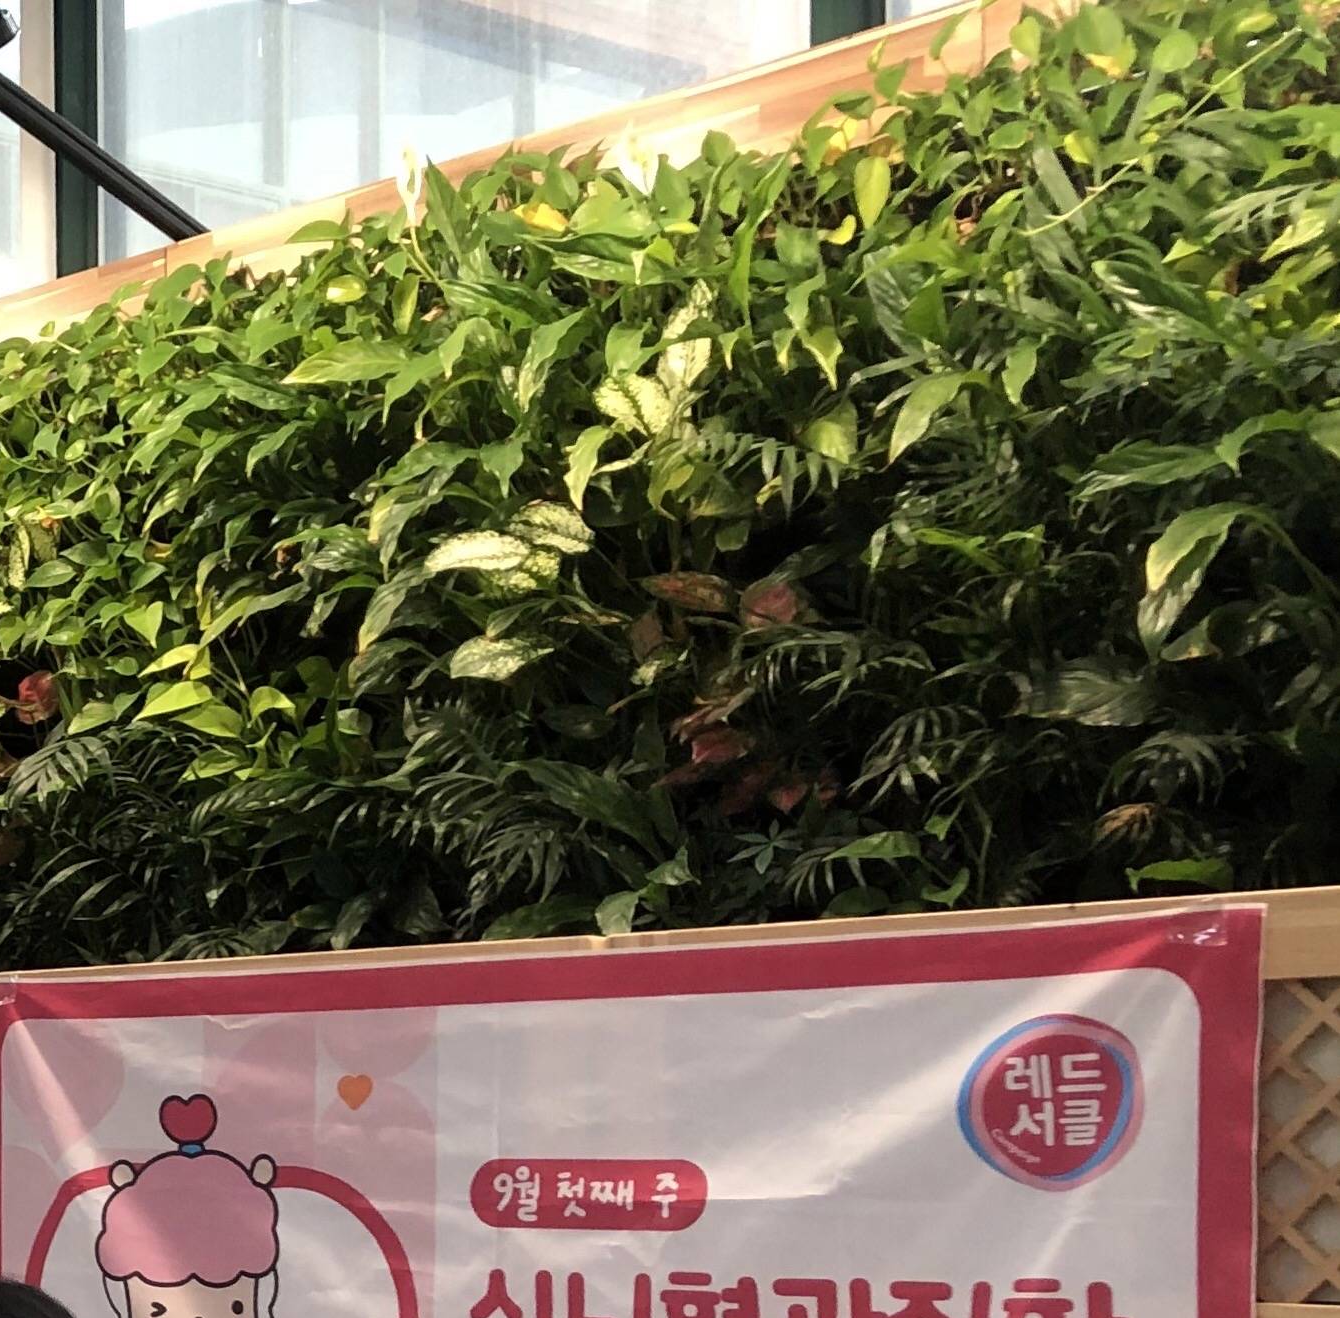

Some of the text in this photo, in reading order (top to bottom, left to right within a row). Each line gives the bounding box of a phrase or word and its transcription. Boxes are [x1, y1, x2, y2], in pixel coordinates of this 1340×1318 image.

[1003, 1052, 1108, 1100] 레드
[1009, 1099, 1104, 1147] 서클
[492, 1165, 680, 1222] 9월 첫째 주
